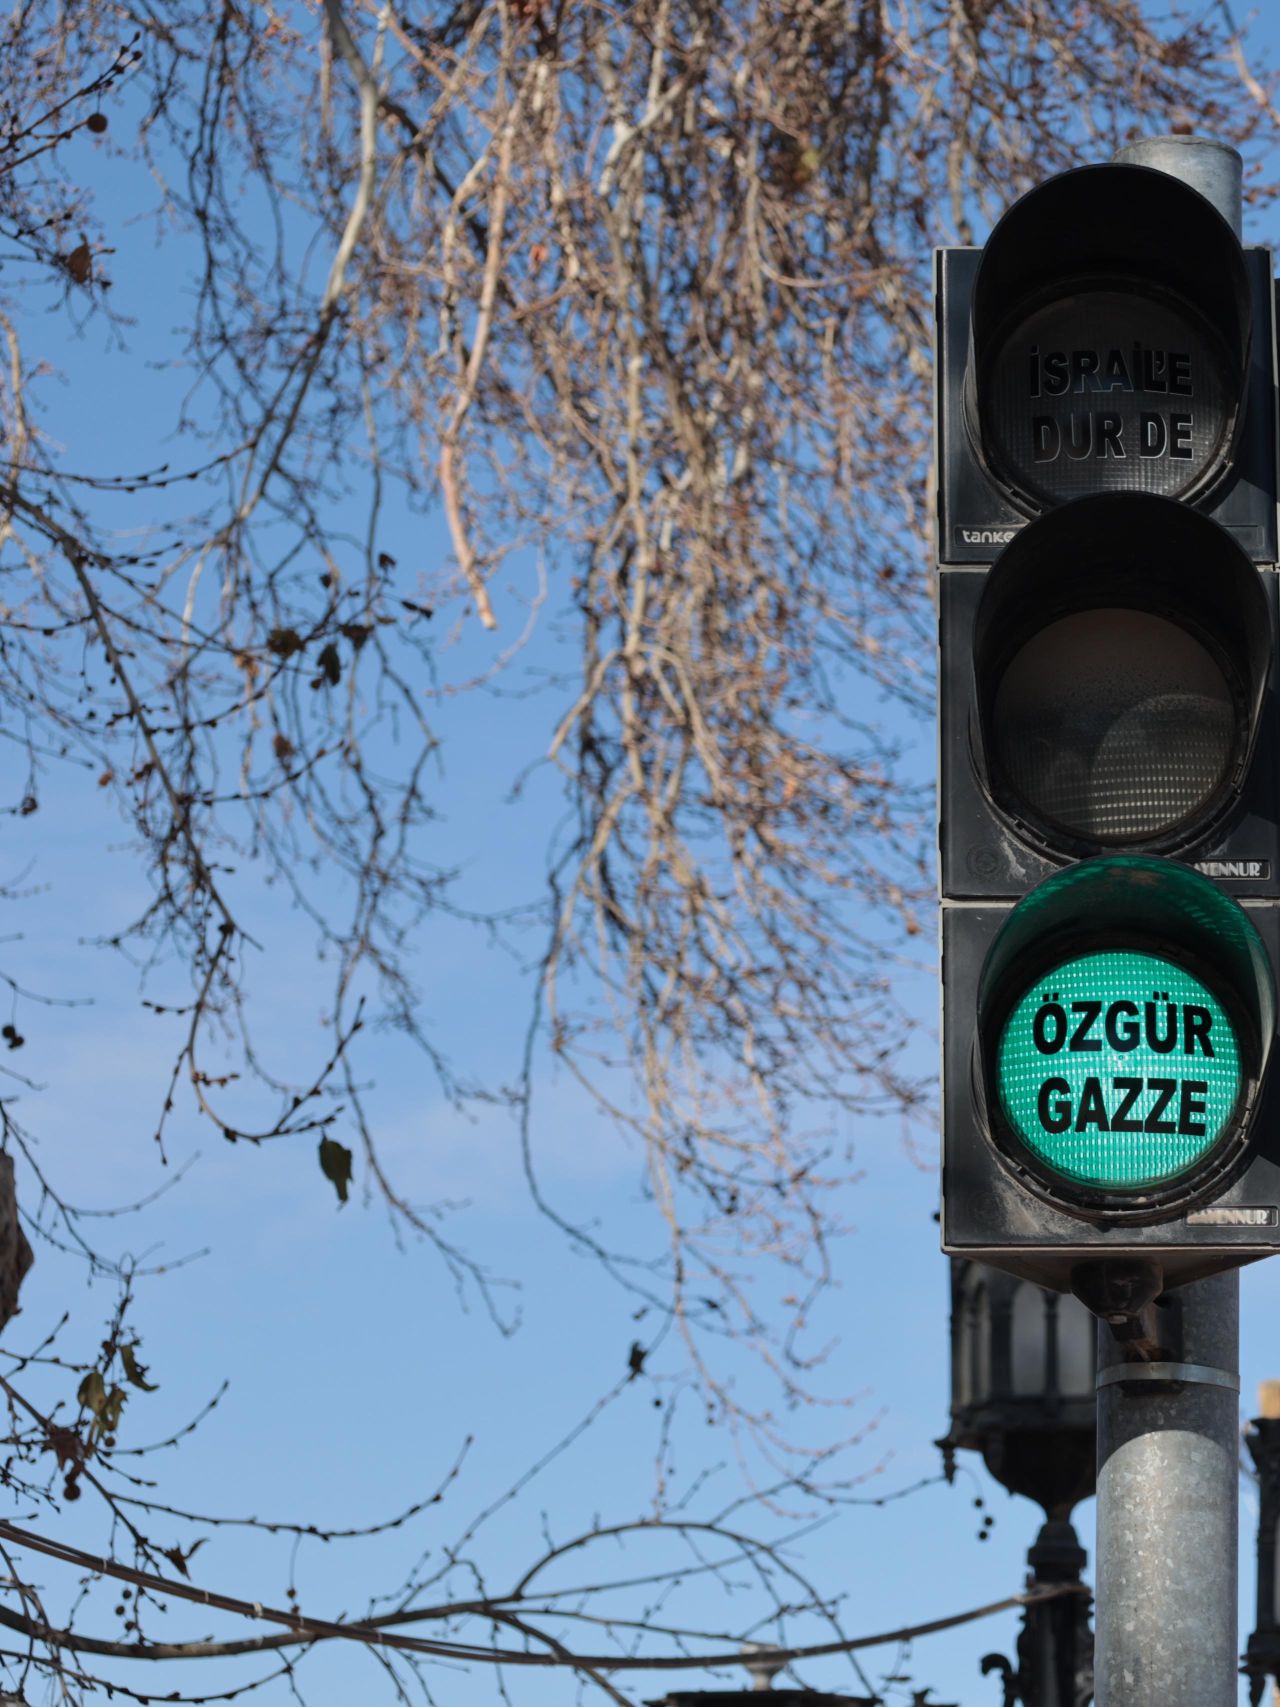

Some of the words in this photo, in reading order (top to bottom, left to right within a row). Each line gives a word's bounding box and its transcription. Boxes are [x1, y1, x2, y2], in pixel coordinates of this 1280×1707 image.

[1032, 412, 1127, 463] DUR
[1139, 412, 1193, 460] DE
[962, 529, 1016, 543] tanke
[1193, 862, 1262, 877] AYENNUR
[1033, 991, 1215, 1057] ÖZGÜR
[1037, 1076, 1208, 1136] GAZZE
